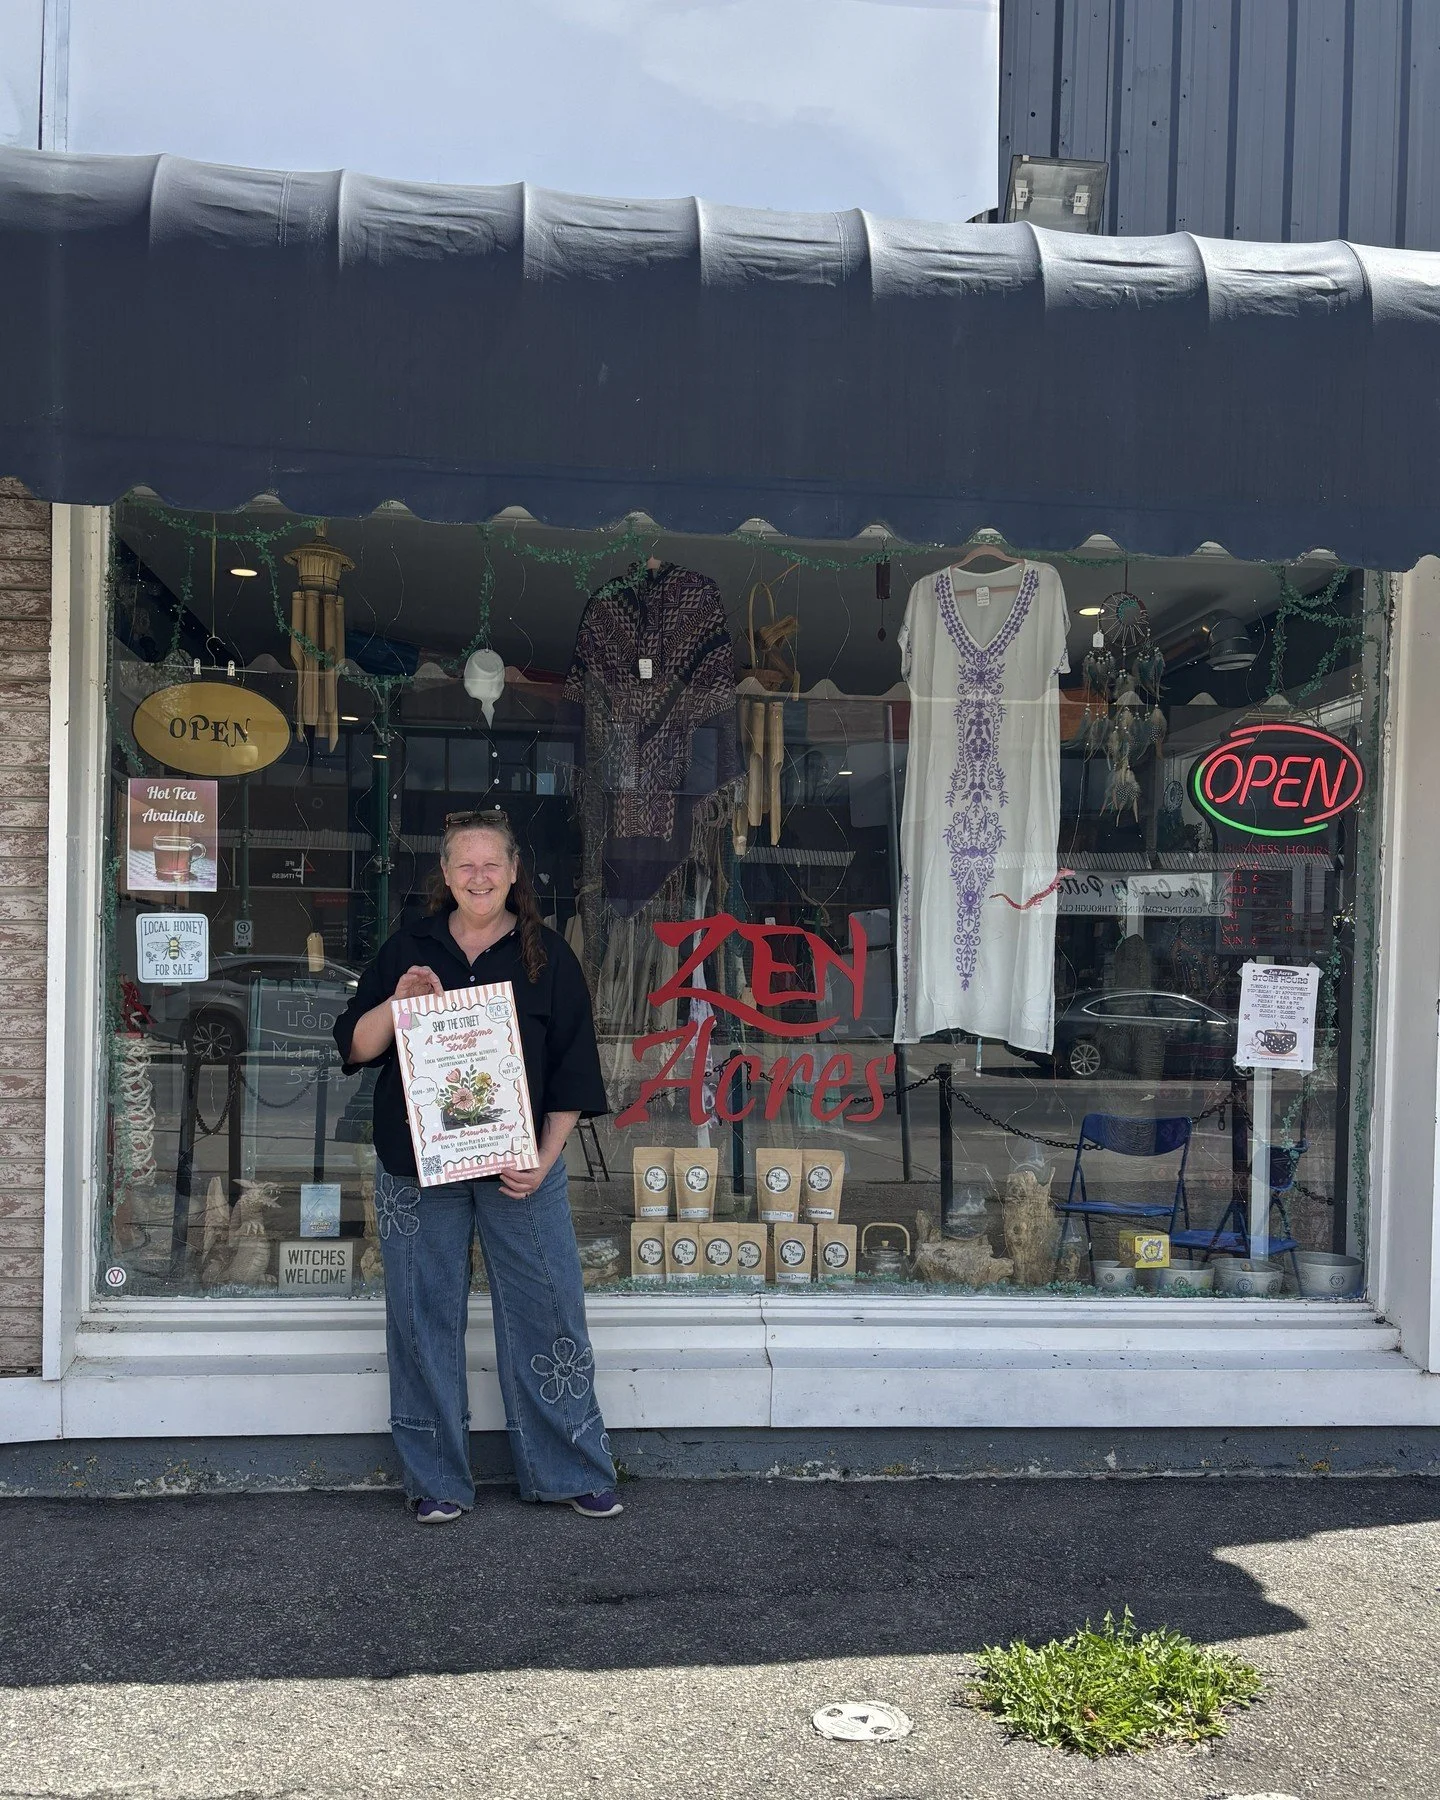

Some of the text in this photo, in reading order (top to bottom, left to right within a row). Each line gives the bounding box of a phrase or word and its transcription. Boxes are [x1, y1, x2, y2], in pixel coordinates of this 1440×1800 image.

[169, 714, 251, 748] OPEN
[1204, 753, 1347, 807] OPEN
[146, 786, 197, 801] Hot Tea
[142, 808, 205, 824] Available
[144, 920, 203, 936] LOCAL HONEY
[155, 963, 193, 976] FOR SALE
[647, 913, 868, 1036] ZEN
[1252, 974, 1308, 984] STORE HOURS
[432, 1014, 479, 1032] SHOP THE STREET
[424, 1028, 493, 1046] A Springtime
[614, 1016, 897, 1129] Acres
[491, 1124, 498, 1132] &
[288, 1250, 345, 1266] WITCHES
[285, 1268, 347, 1285] WELCOME
